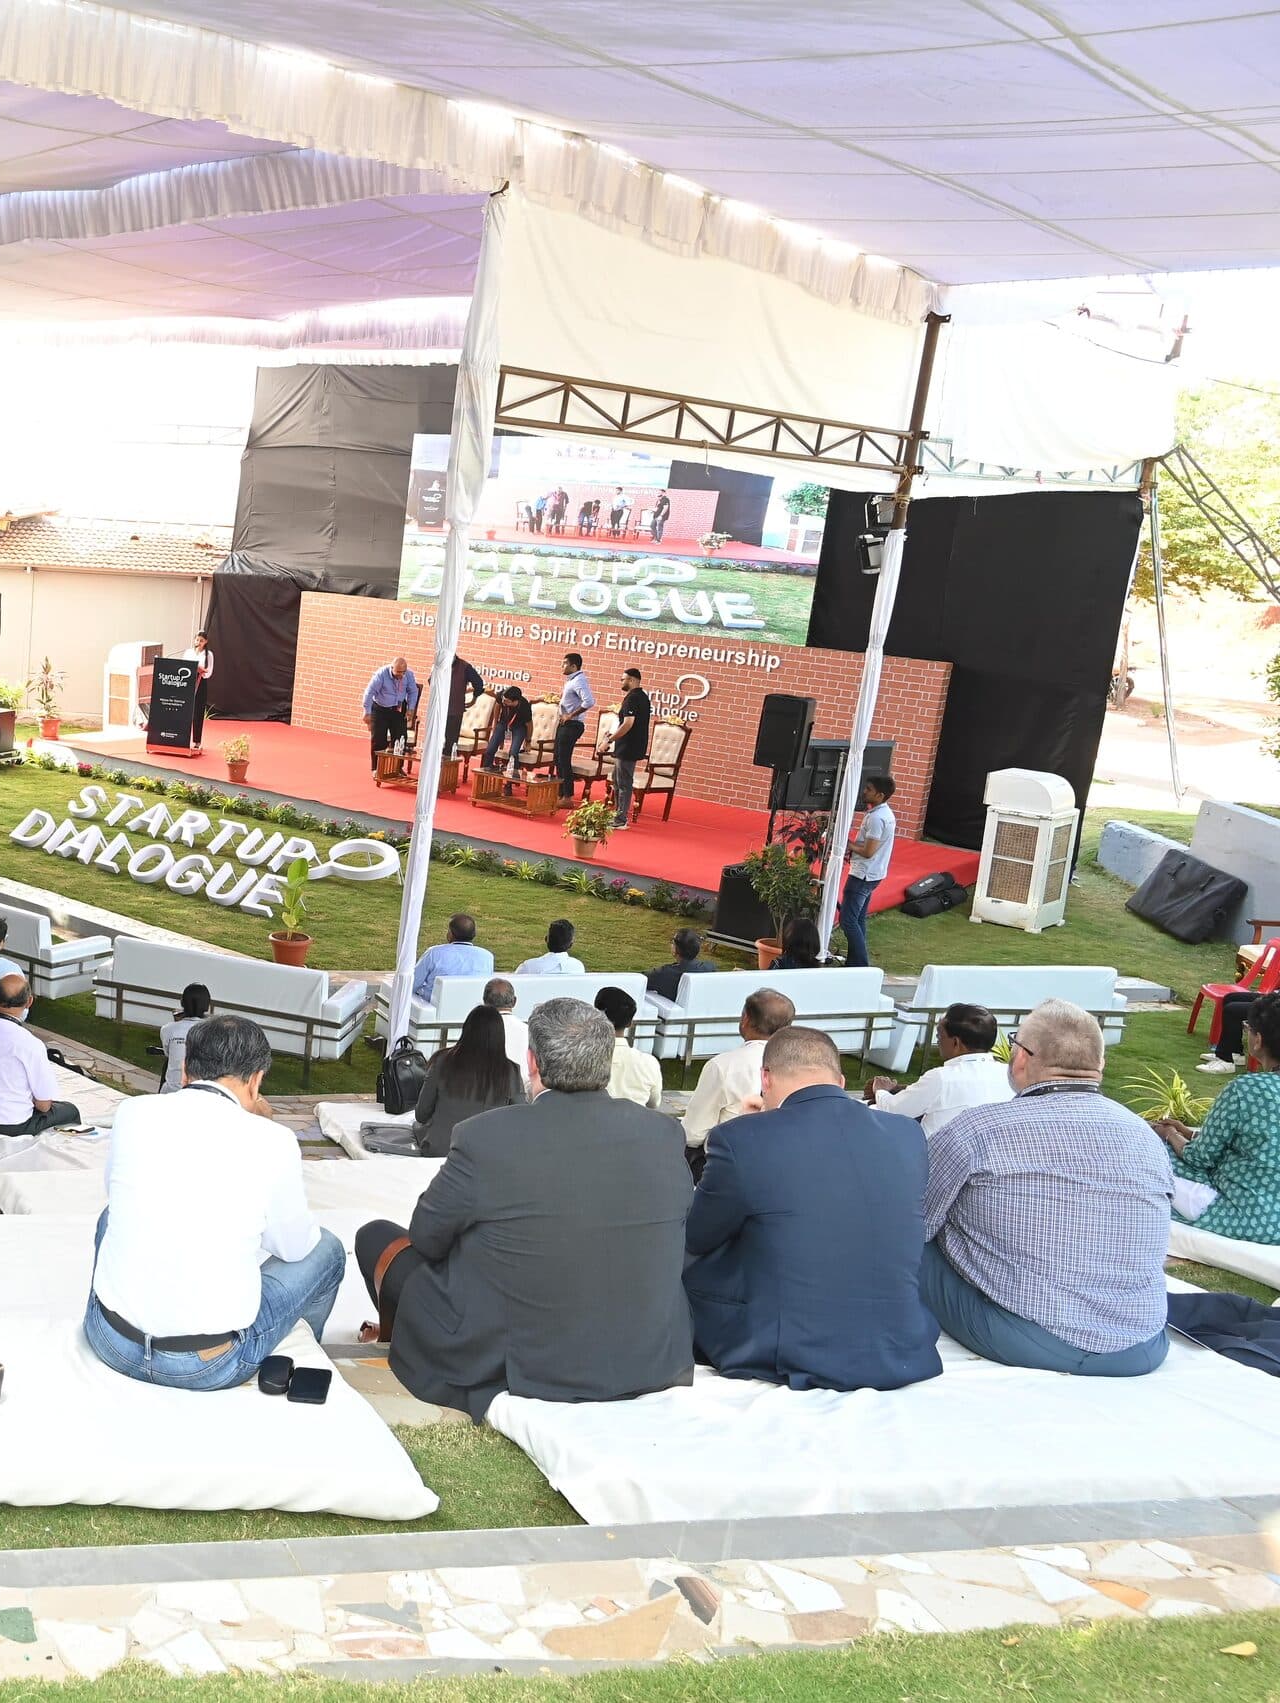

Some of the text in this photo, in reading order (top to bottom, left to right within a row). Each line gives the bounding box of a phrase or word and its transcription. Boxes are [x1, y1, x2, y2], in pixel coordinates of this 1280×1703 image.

[400, 608, 781, 671] Celeting the Spirit of Entrepreneurship
[158, 672, 180, 681] Startup
[476, 664, 531, 682] shpande
[650, 703, 698, 722] alogue
[67, 785, 318, 873] STARTUP
[8, 808, 289, 918] DIALOGUE
